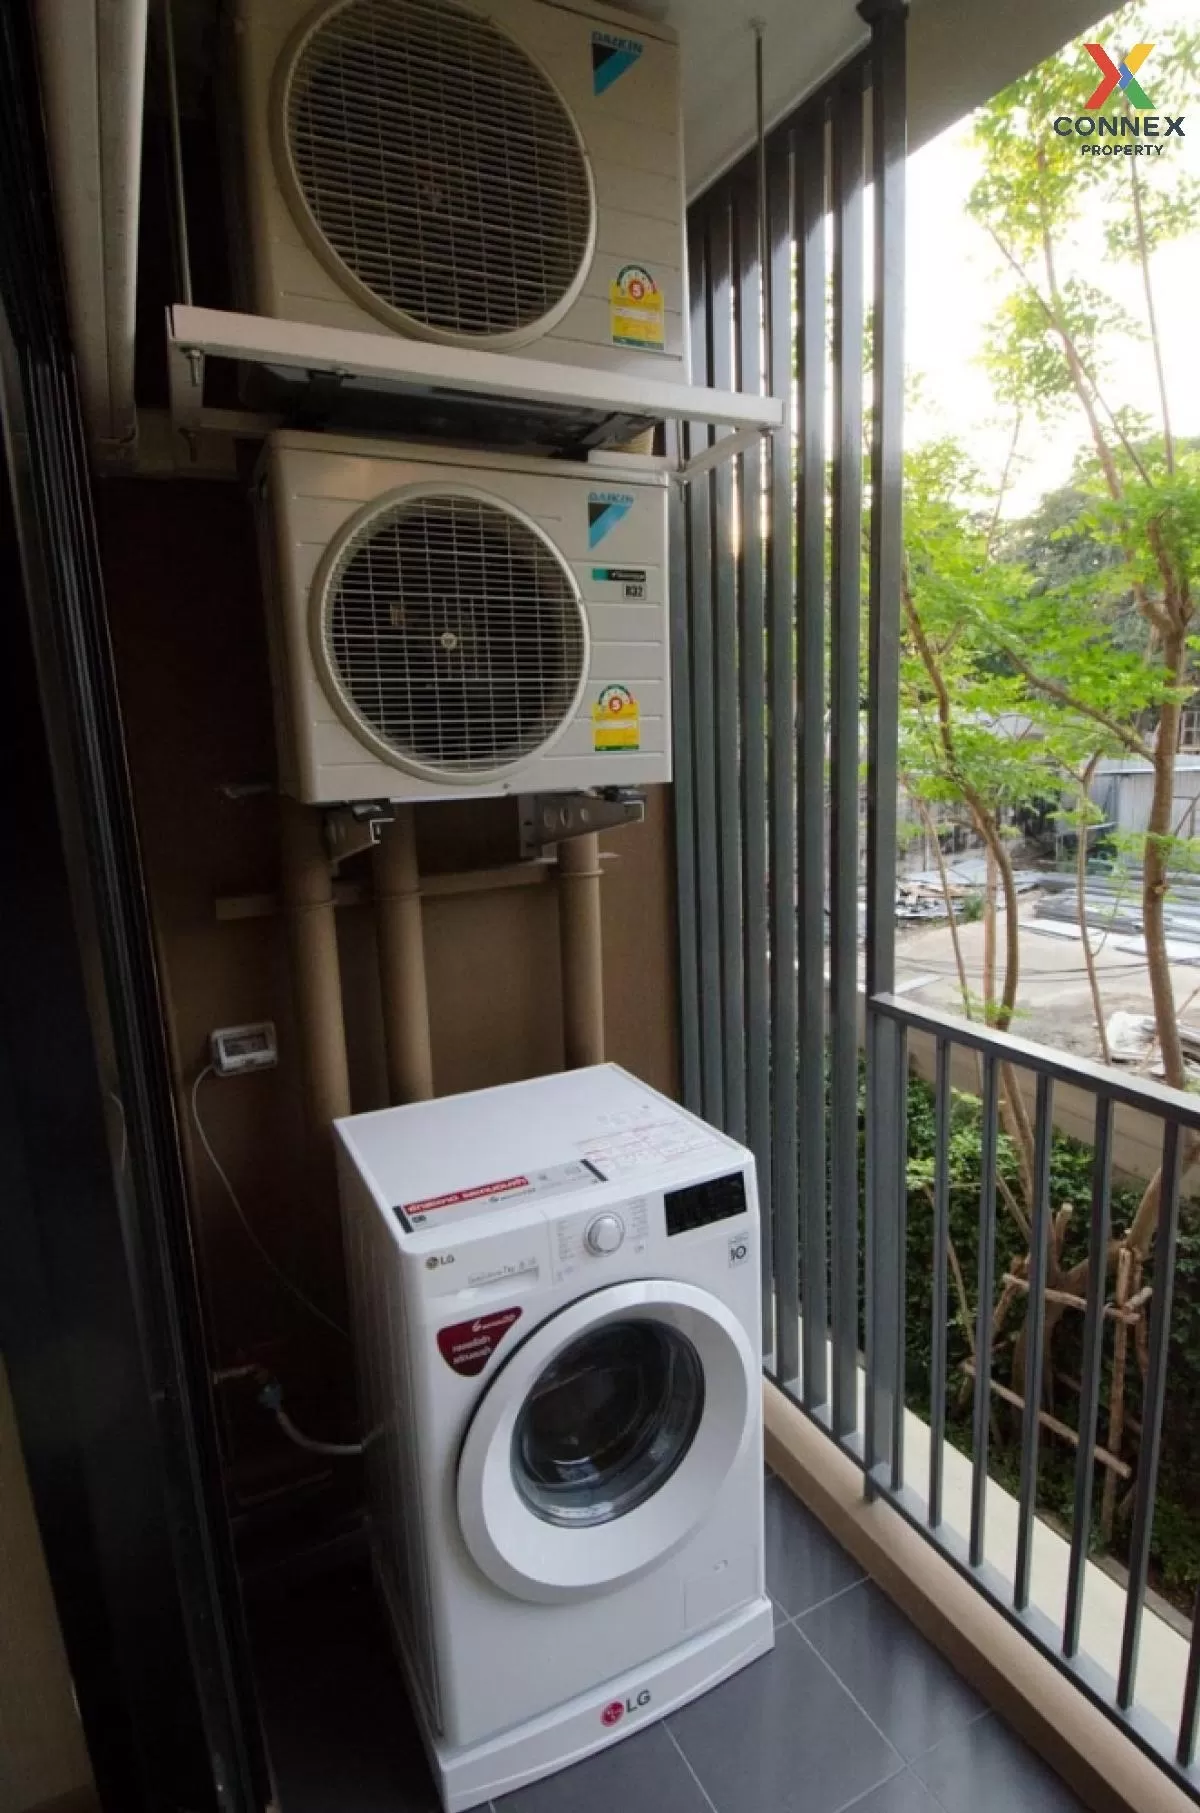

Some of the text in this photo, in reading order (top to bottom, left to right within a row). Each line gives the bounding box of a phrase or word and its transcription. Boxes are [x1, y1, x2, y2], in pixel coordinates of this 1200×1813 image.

[625, 585, 643, 598] R32
[440, 1254, 455, 1265] LG
[626, 1690, 651, 1712] LG
